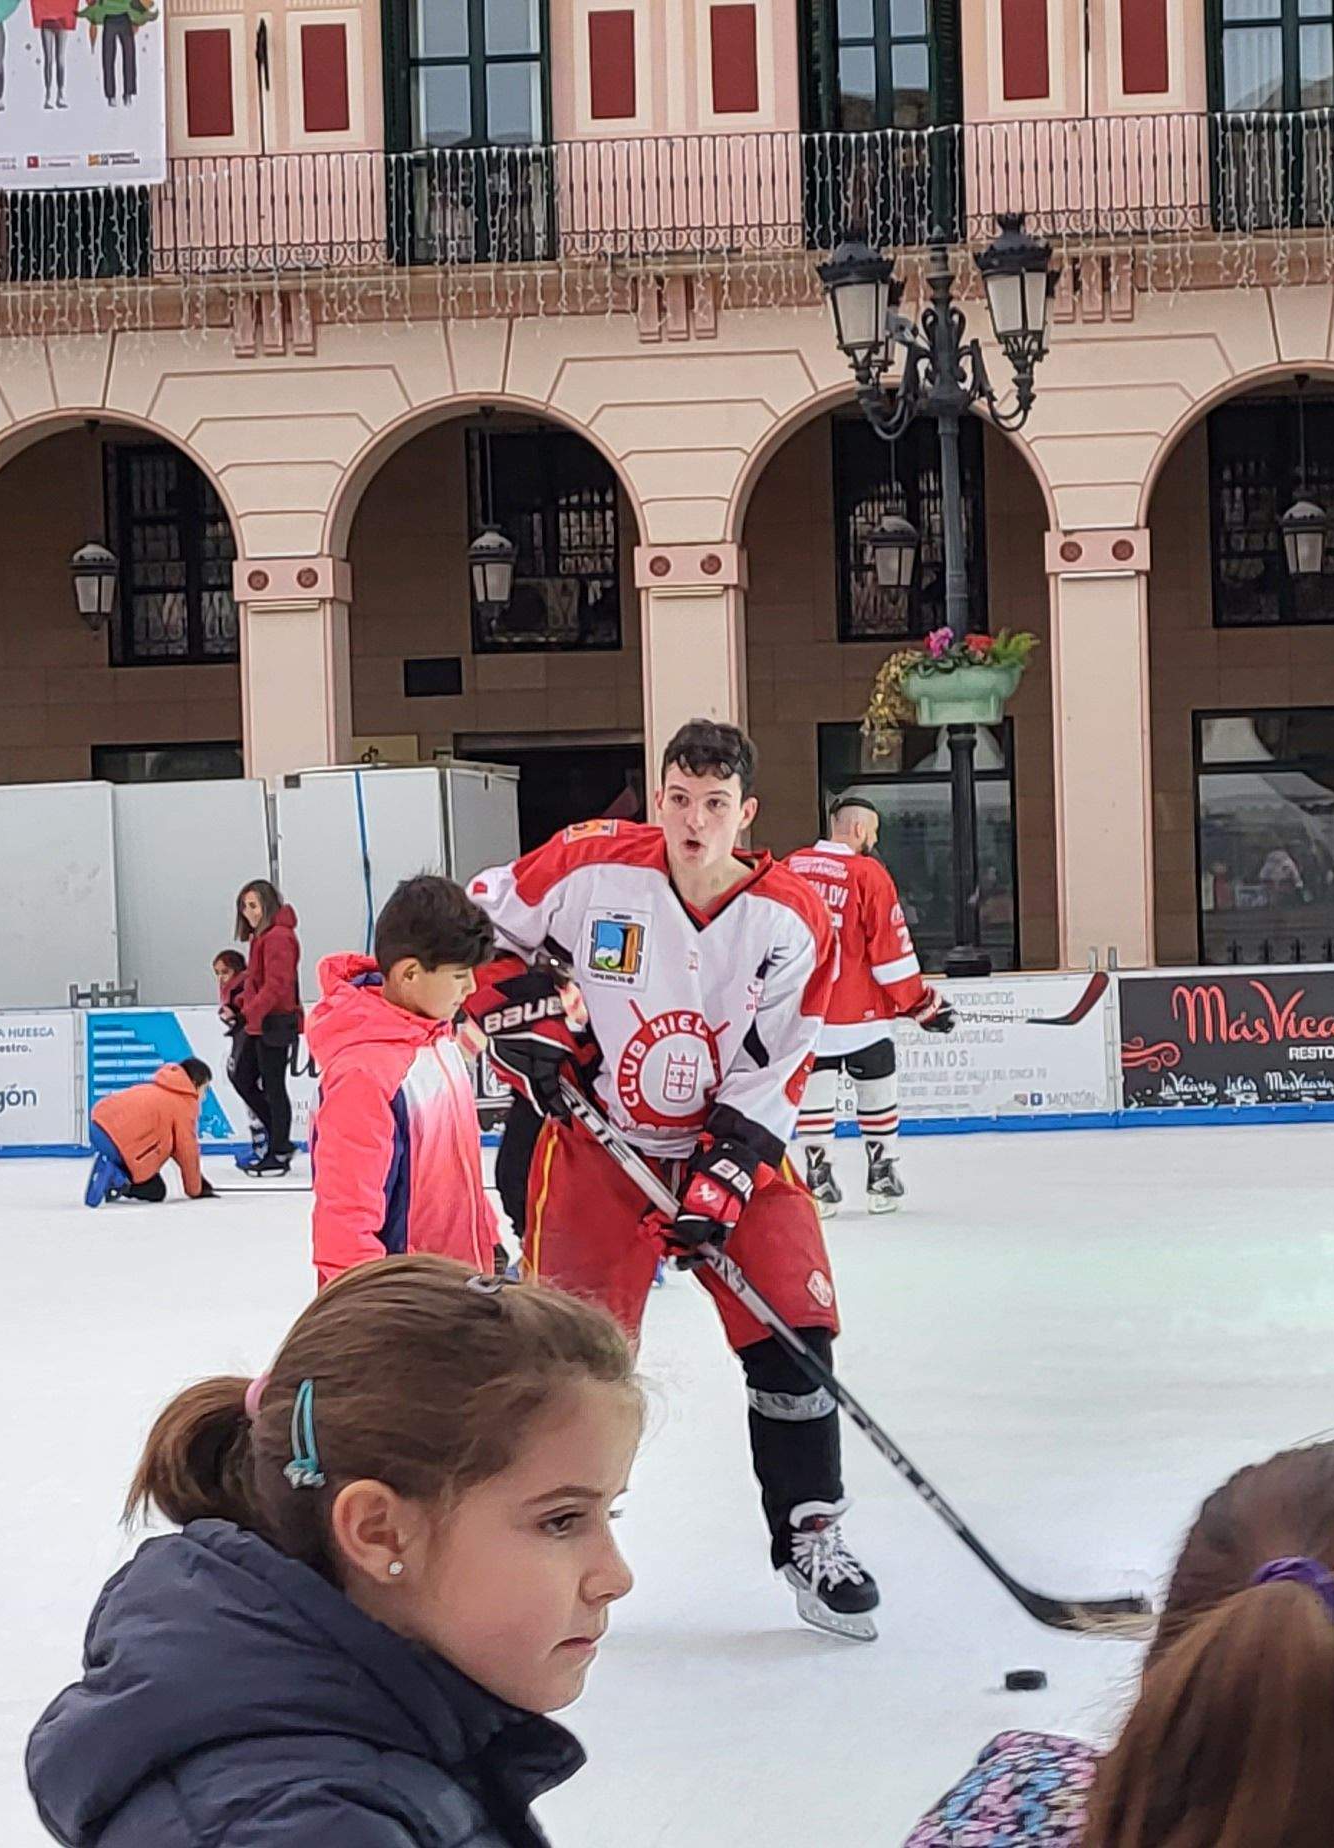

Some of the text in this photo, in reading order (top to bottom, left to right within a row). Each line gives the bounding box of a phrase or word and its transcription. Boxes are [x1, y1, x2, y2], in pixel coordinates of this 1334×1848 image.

[8, 1027, 54, 1038] HUESCA
[620, 1013, 708, 1107] CLUB HIEL
